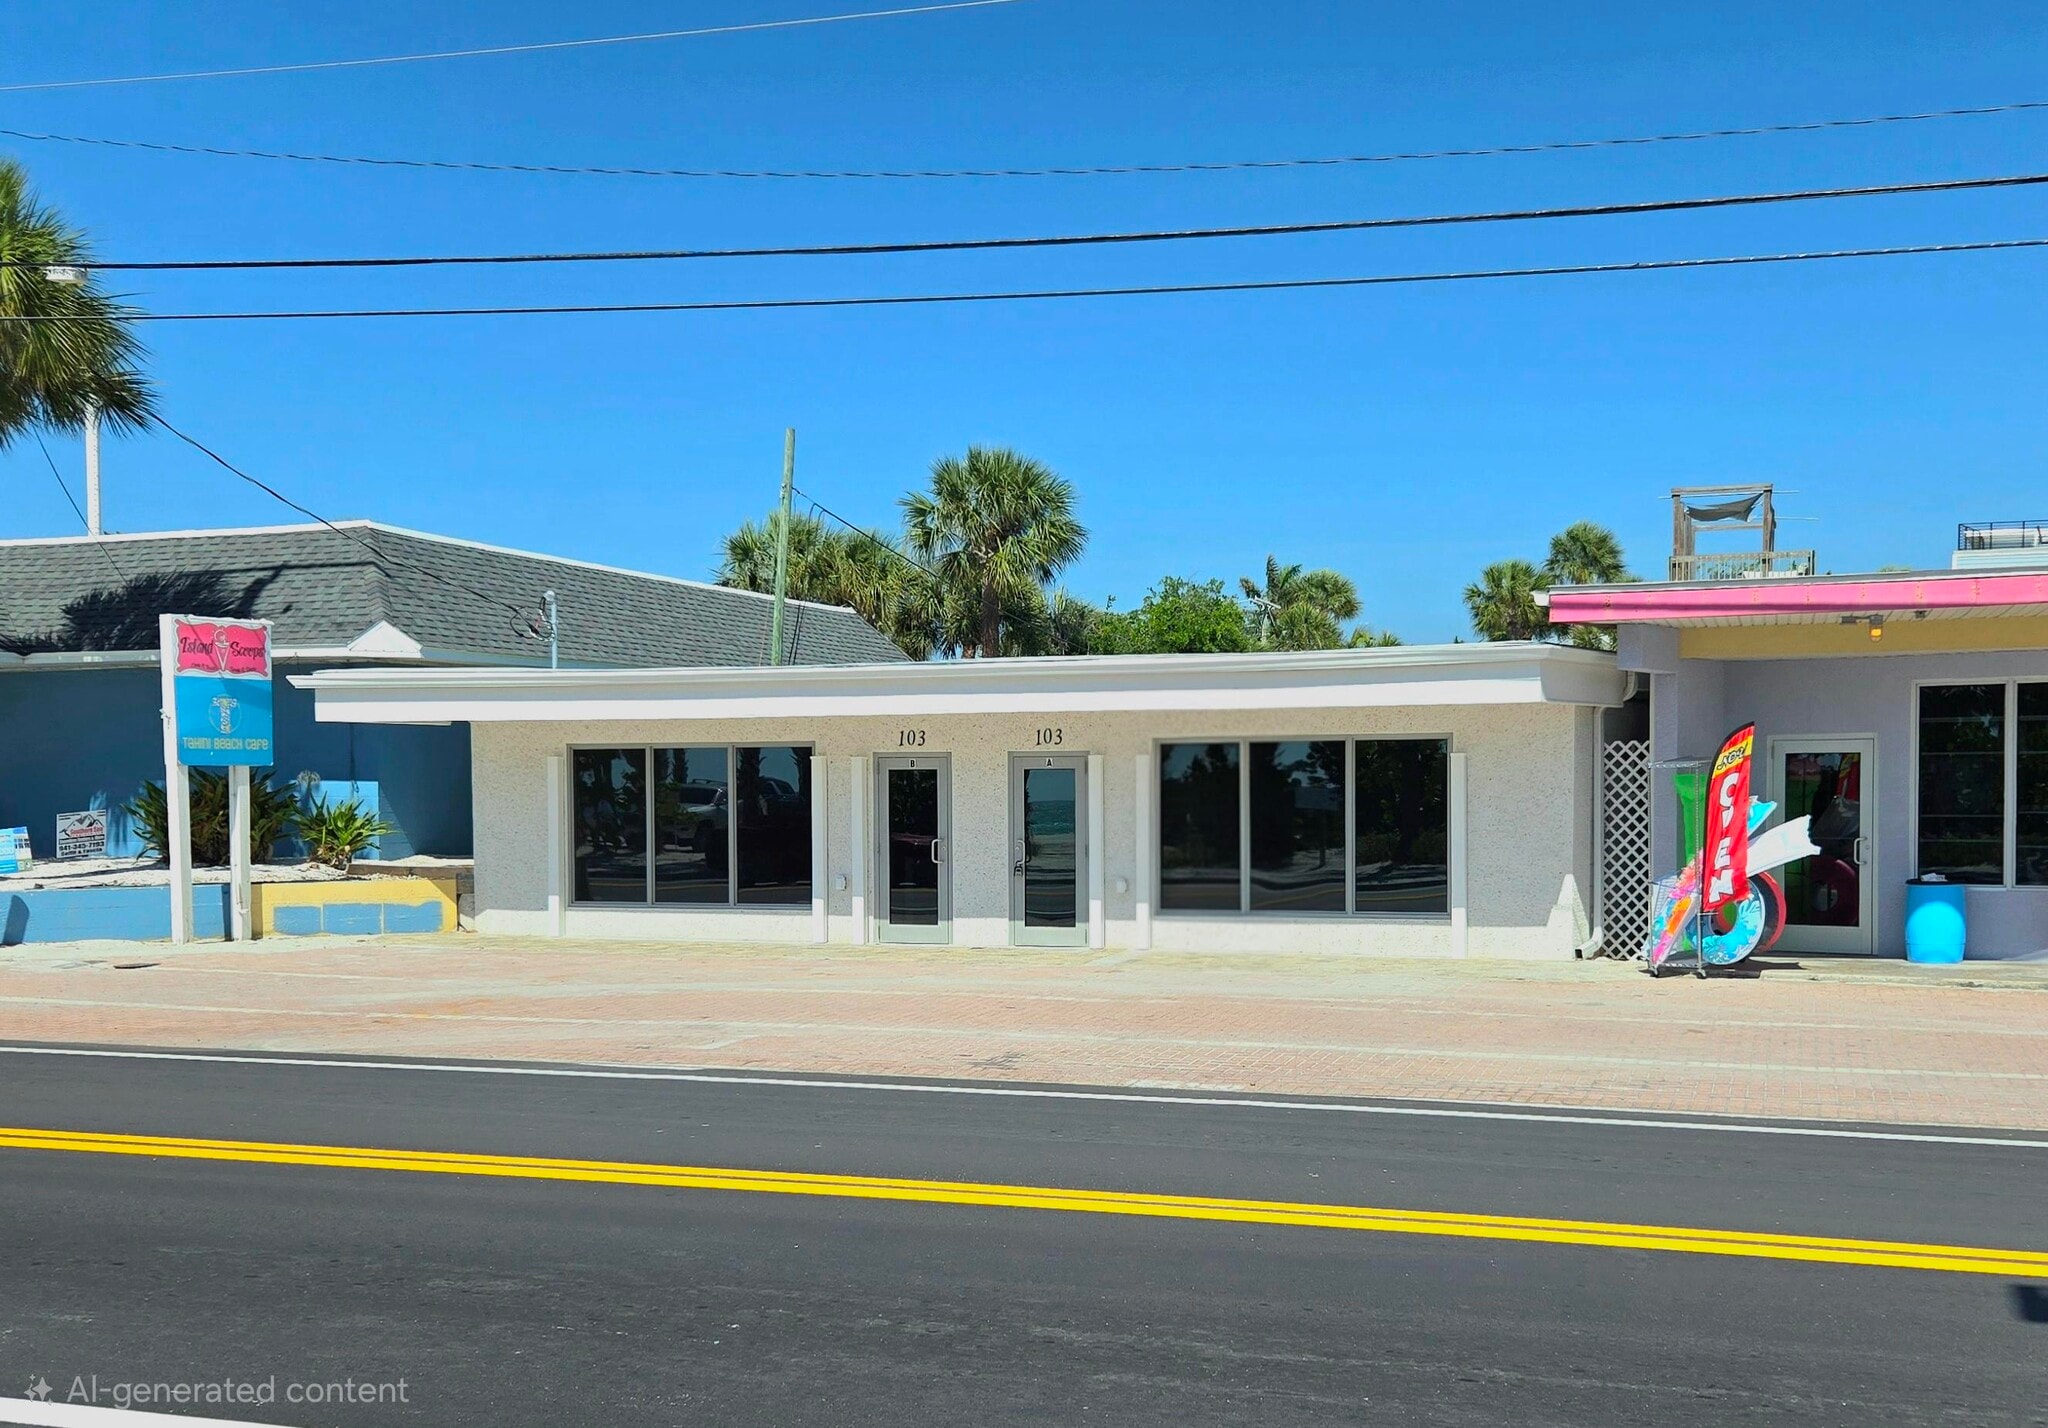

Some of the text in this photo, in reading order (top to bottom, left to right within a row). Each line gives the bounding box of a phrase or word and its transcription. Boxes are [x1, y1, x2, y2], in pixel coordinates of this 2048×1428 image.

[180, 636, 214, 656] Island
[898, 729, 926, 747] 103
[1035, 728, 1063, 746] 103
[910, 759, 916, 768] B
[1046, 758, 1052, 767] A
